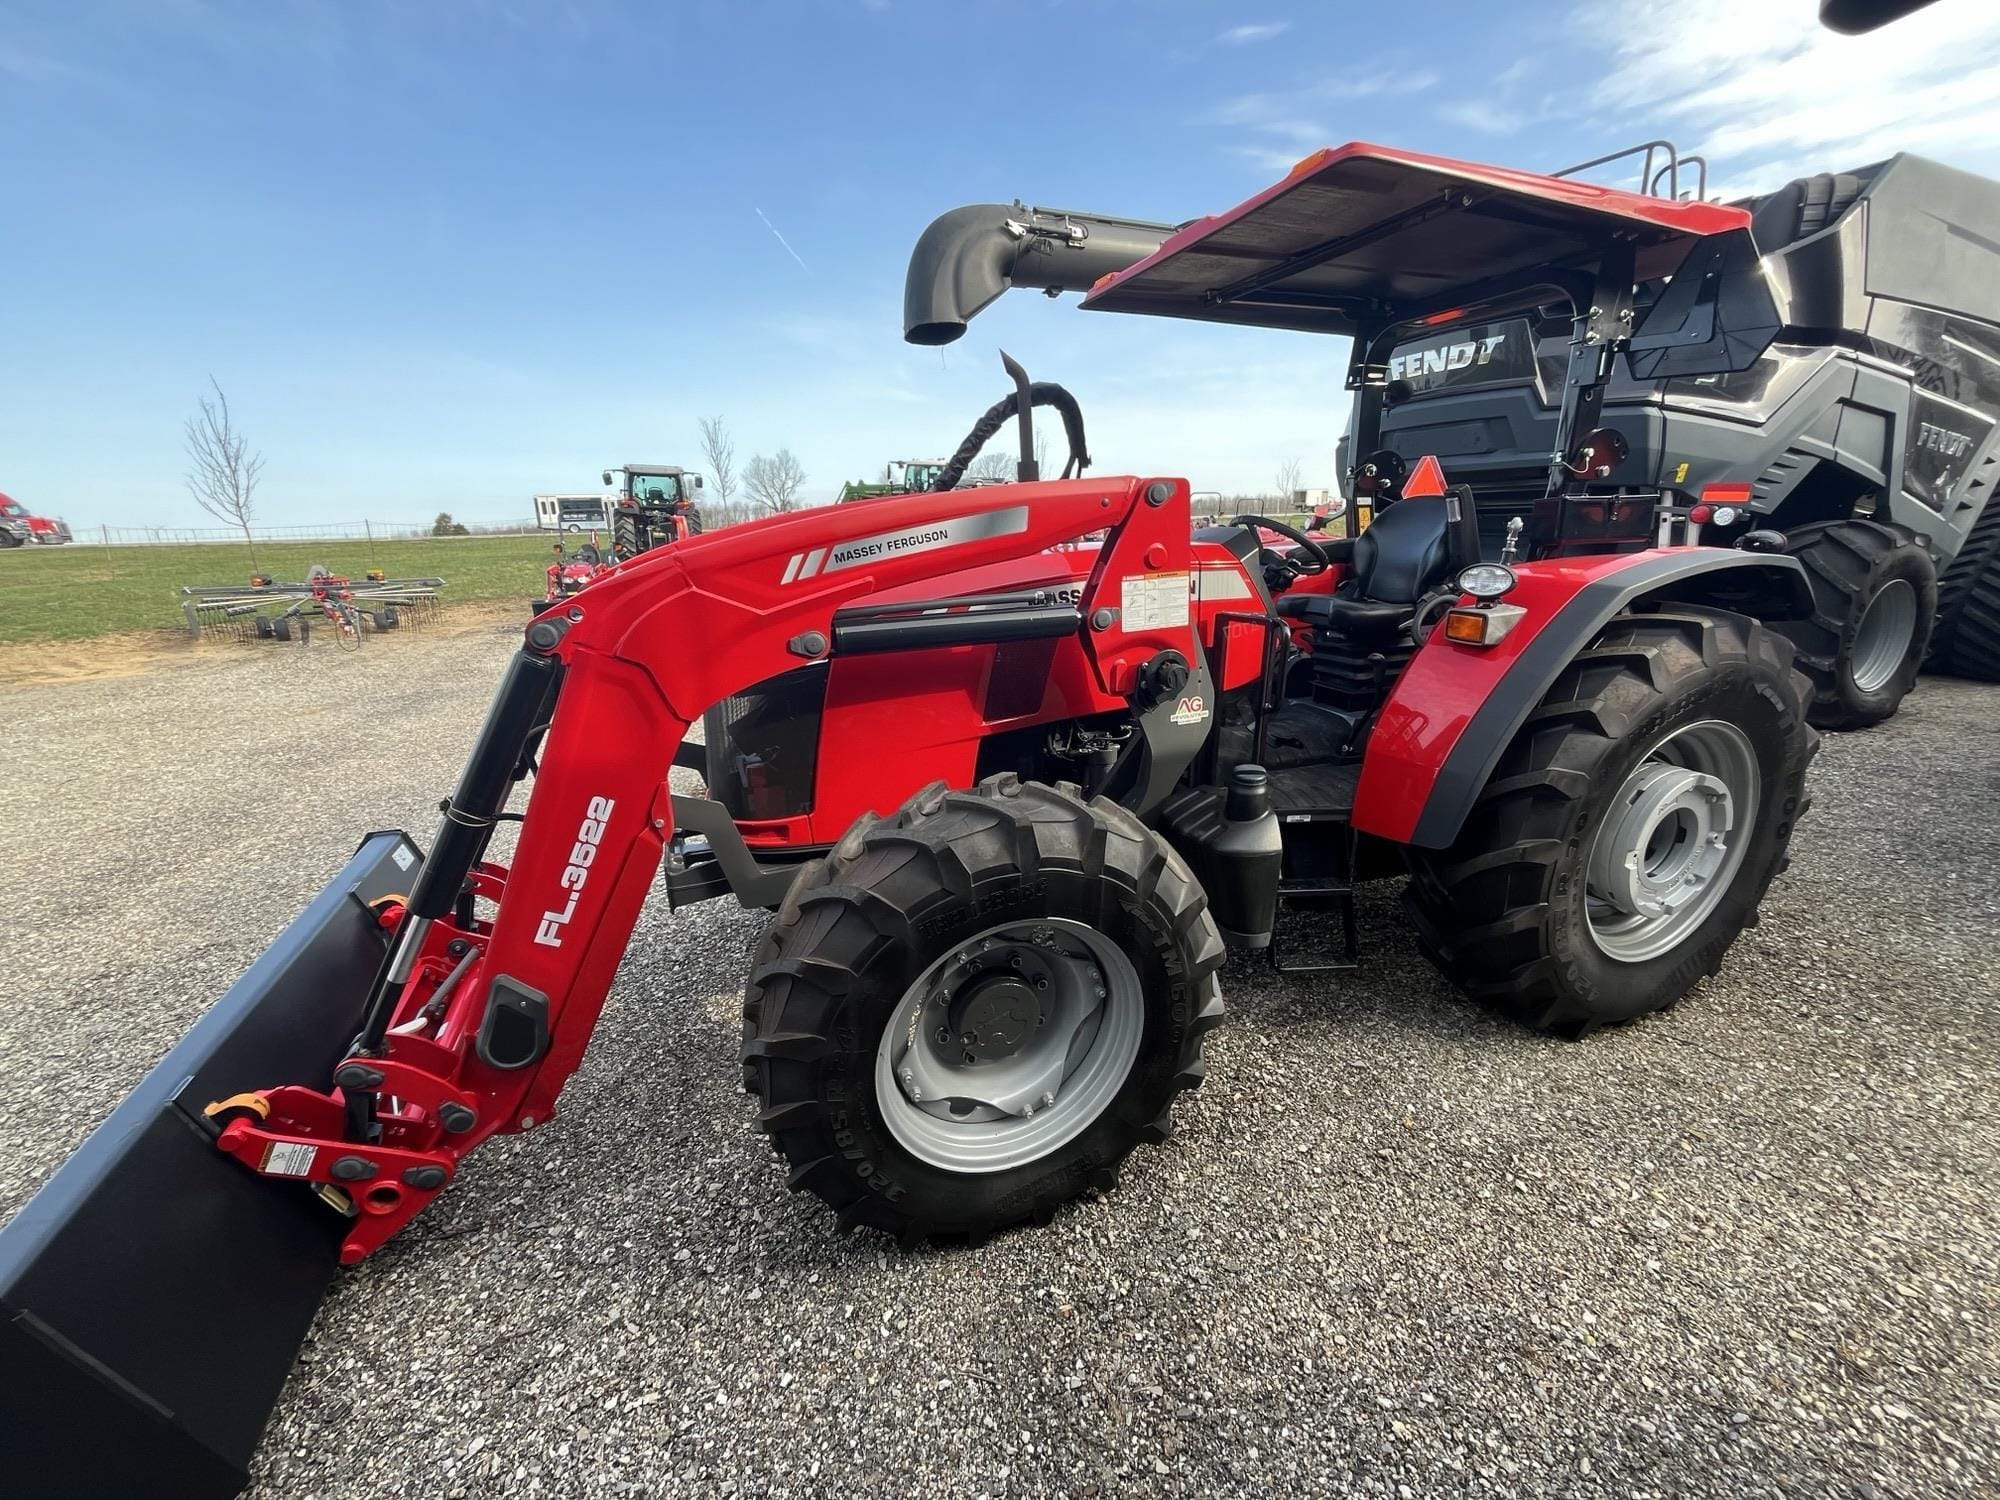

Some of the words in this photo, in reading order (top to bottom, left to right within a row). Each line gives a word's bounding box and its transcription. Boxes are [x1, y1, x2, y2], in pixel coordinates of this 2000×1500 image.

[1391, 335, 1506, 380] FENDT
[1917, 422, 1972, 457] FENDT
[834, 543, 883, 564] MASSEY
[887, 529, 949, 551] FERGUSON
[1178, 697, 1202, 713] AG
[534, 796, 615, 948] FL.3522
